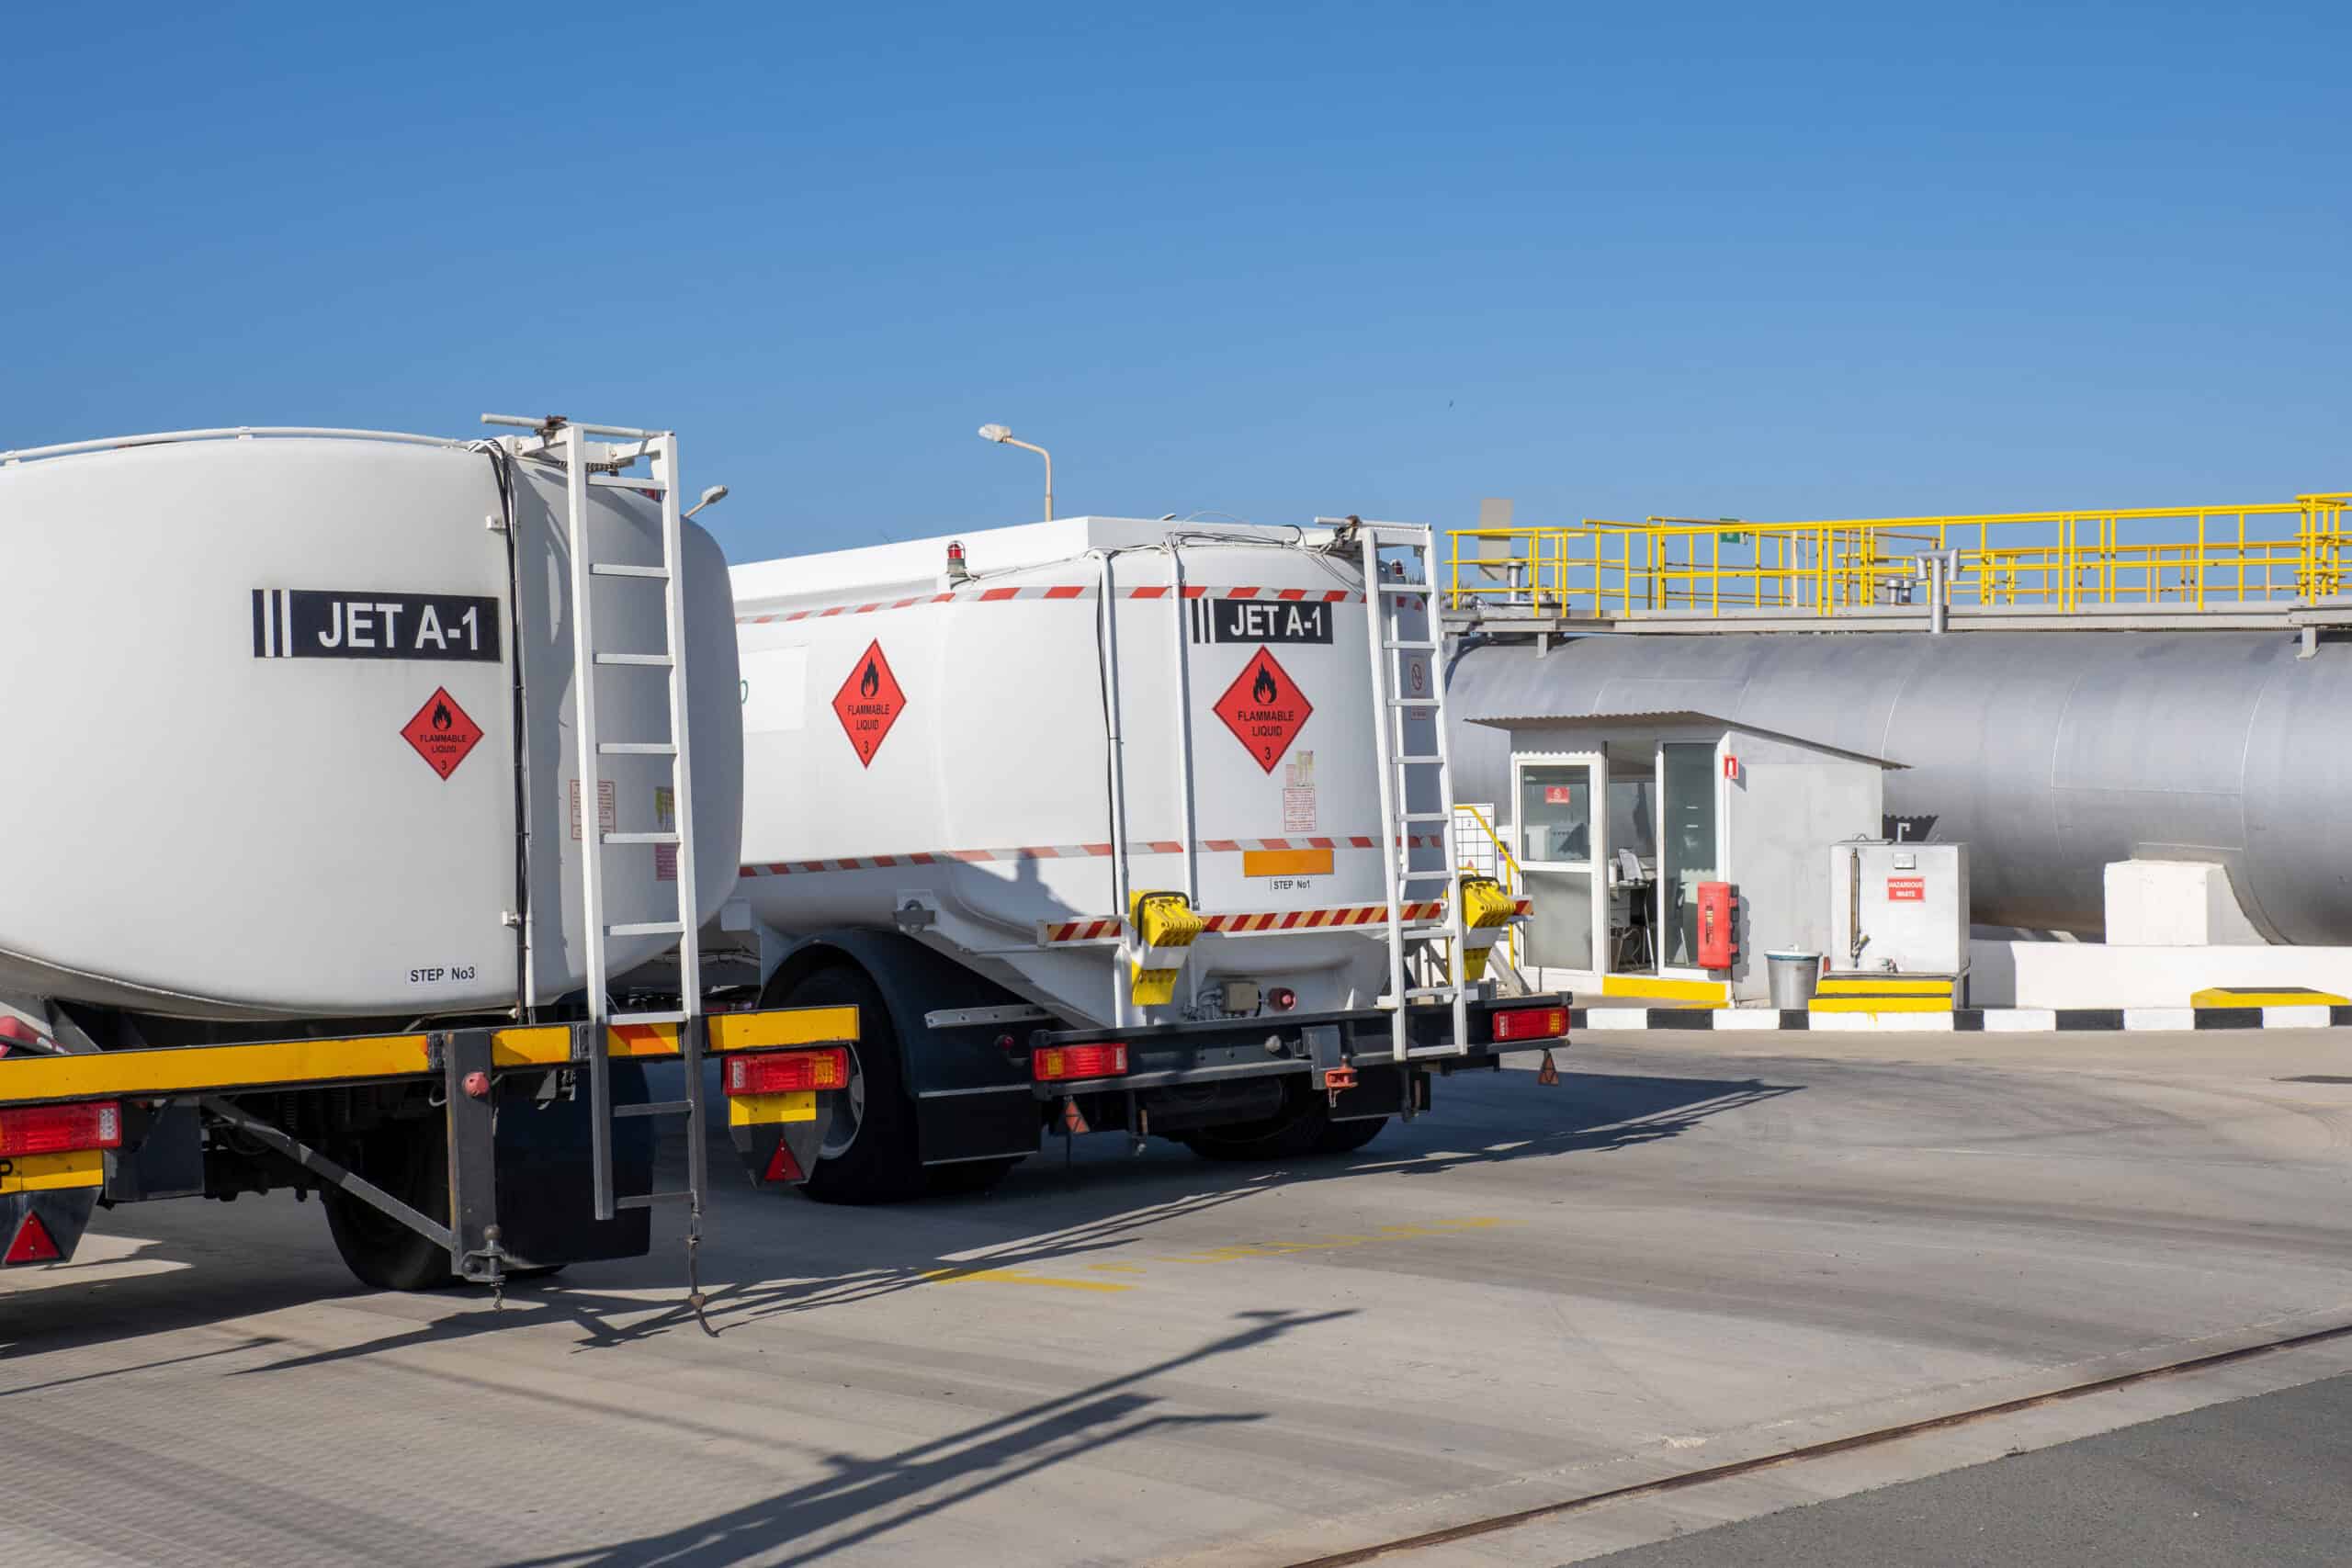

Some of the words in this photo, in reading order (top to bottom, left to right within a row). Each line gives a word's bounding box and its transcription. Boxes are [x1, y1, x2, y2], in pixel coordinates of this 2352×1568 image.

[318, 602, 403, 649] JET
[414, 604, 479, 651] A-1
[1230, 604, 1280, 637] JET
[1285, 604, 1323, 637] A-1
[847, 704, 890, 716] FLAMMABLE
[1238, 710, 1295, 722] FLAMMABLE
[855, 719, 879, 731] LIQUID
[1251, 725, 1283, 737] LIQUID
[419, 734, 467, 743] FLAMMABLE
[864, 739, 869, 754] 3
[1264, 746, 1272, 761] 3
[441, 760, 447, 771] 3
[1273, 880, 1294, 890] STEP
[410, 967, 445, 983] STEP
[450, 965, 476, 981] No3
